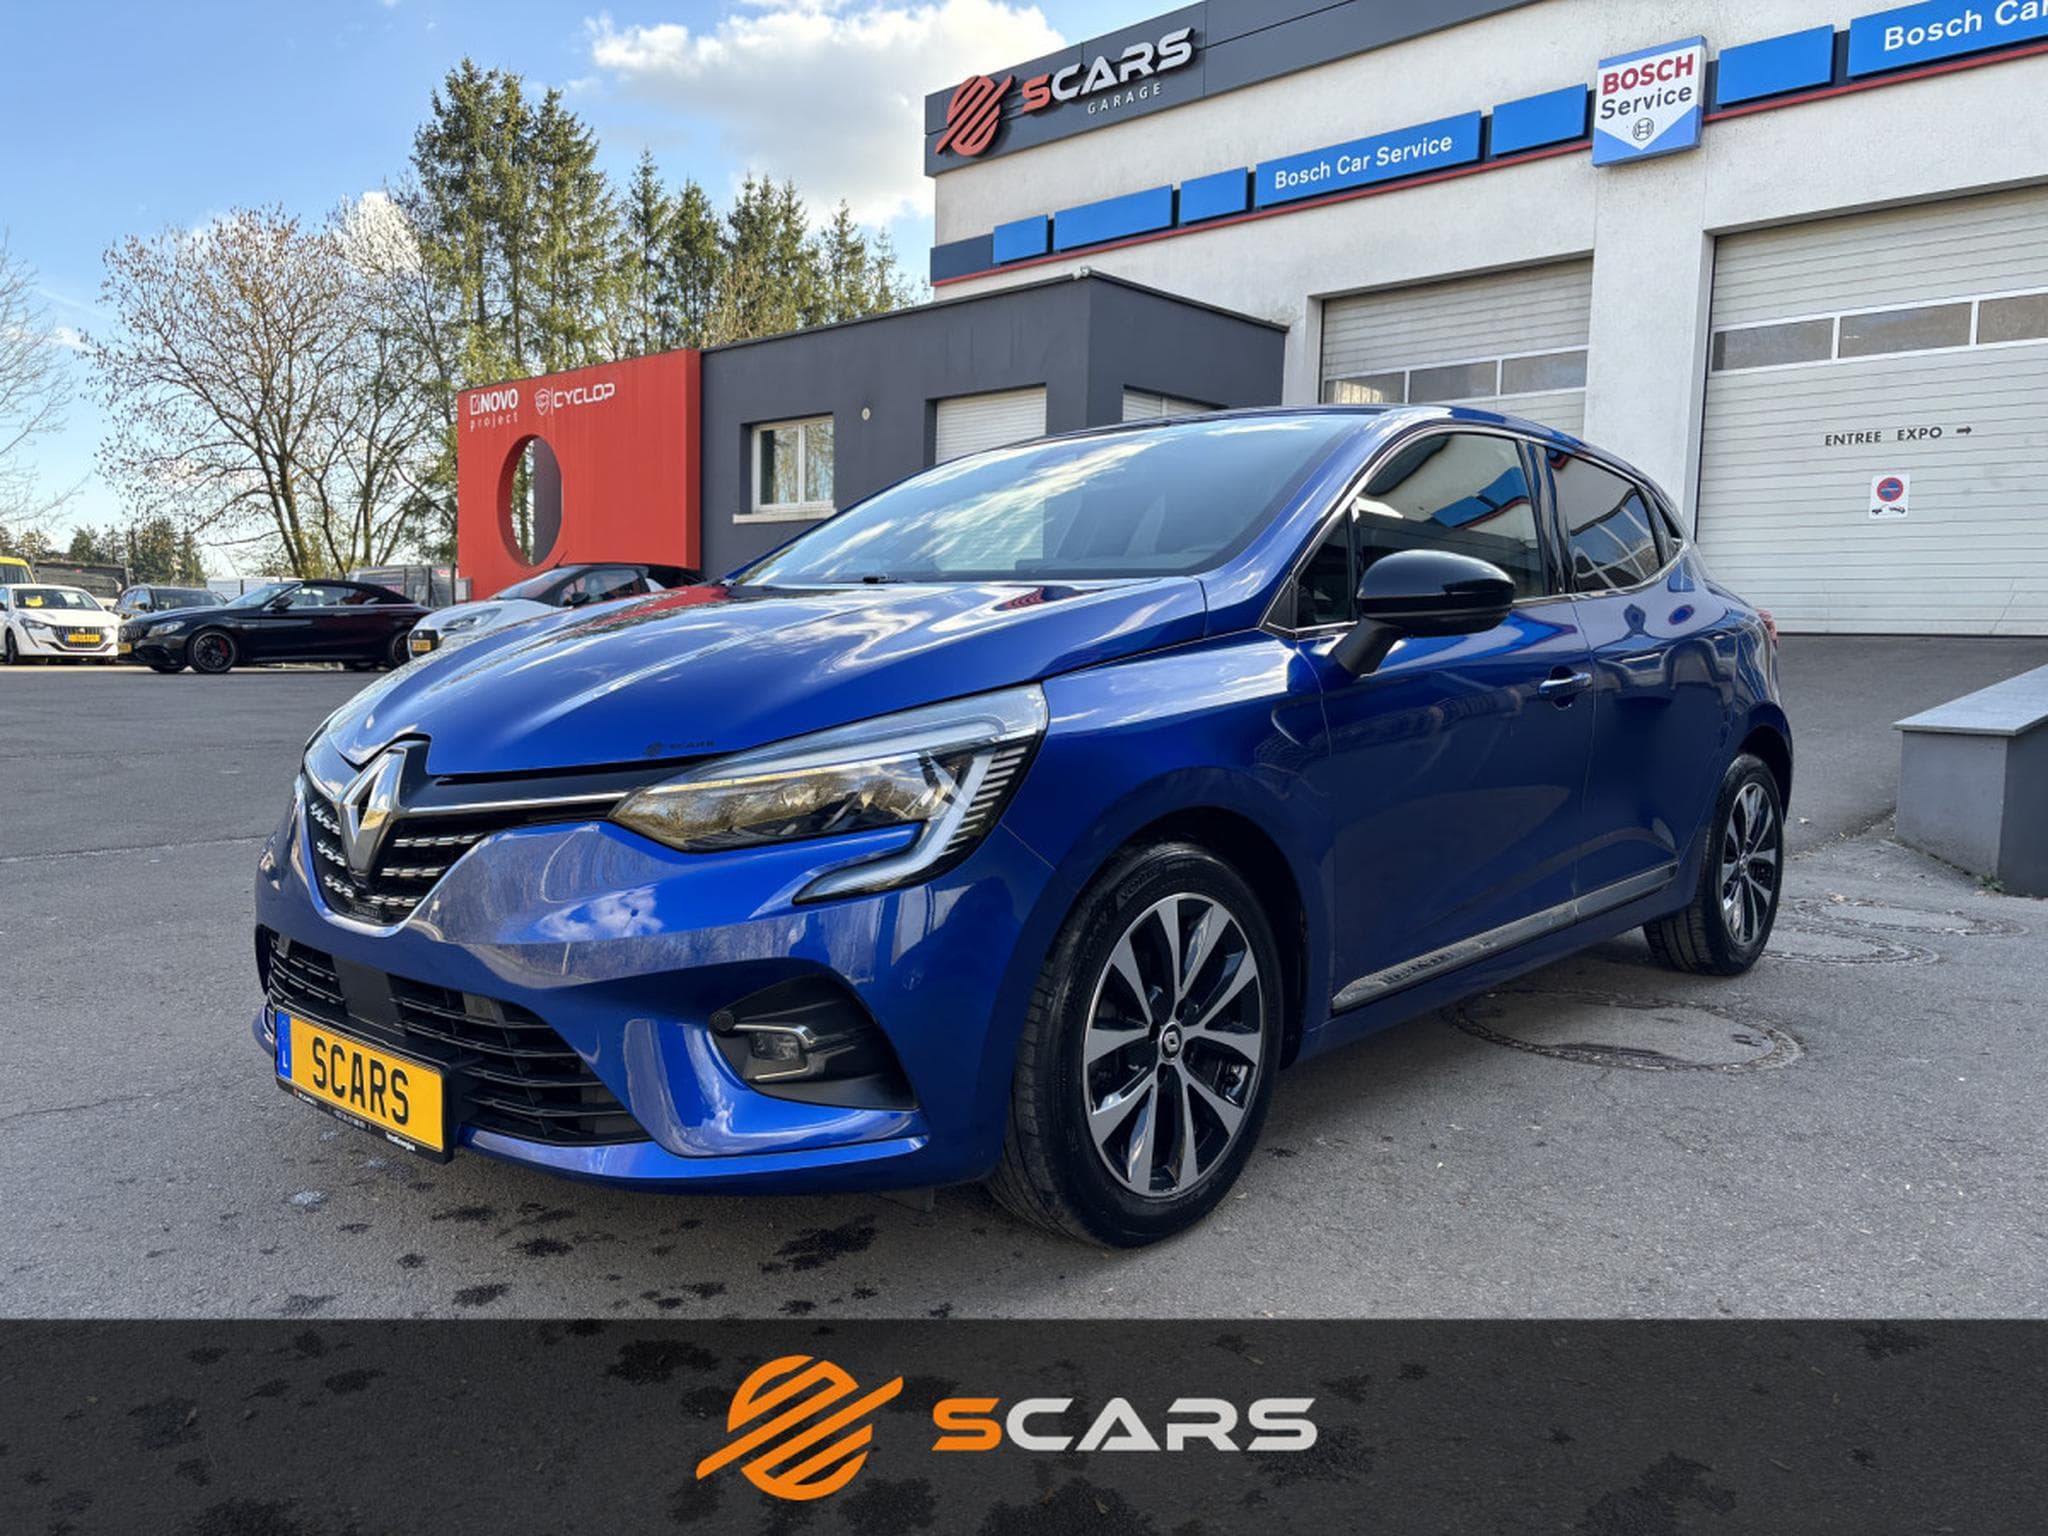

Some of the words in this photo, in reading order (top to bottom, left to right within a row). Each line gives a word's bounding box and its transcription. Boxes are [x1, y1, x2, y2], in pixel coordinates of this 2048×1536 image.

[1883, 9, 1983, 51] Bosch
[1021, 26, 1193, 113] SCARS
[1602, 53, 1694, 96] BOSCH
[1087, 82, 1162, 115] GARAGE
[1600, 87, 1692, 120] Service
[1274, 160, 1331, 190] Bosch
[1336, 155, 1370, 175] Car
[1376, 136, 1453, 167] Service
[553, 383, 616, 408] CYCLOP
[470, 411, 518, 432] project
[1825, 431, 1882, 446] ENTREE
[1897, 426, 1943, 441] EXPO
[312, 1036, 409, 1126] SCARS
